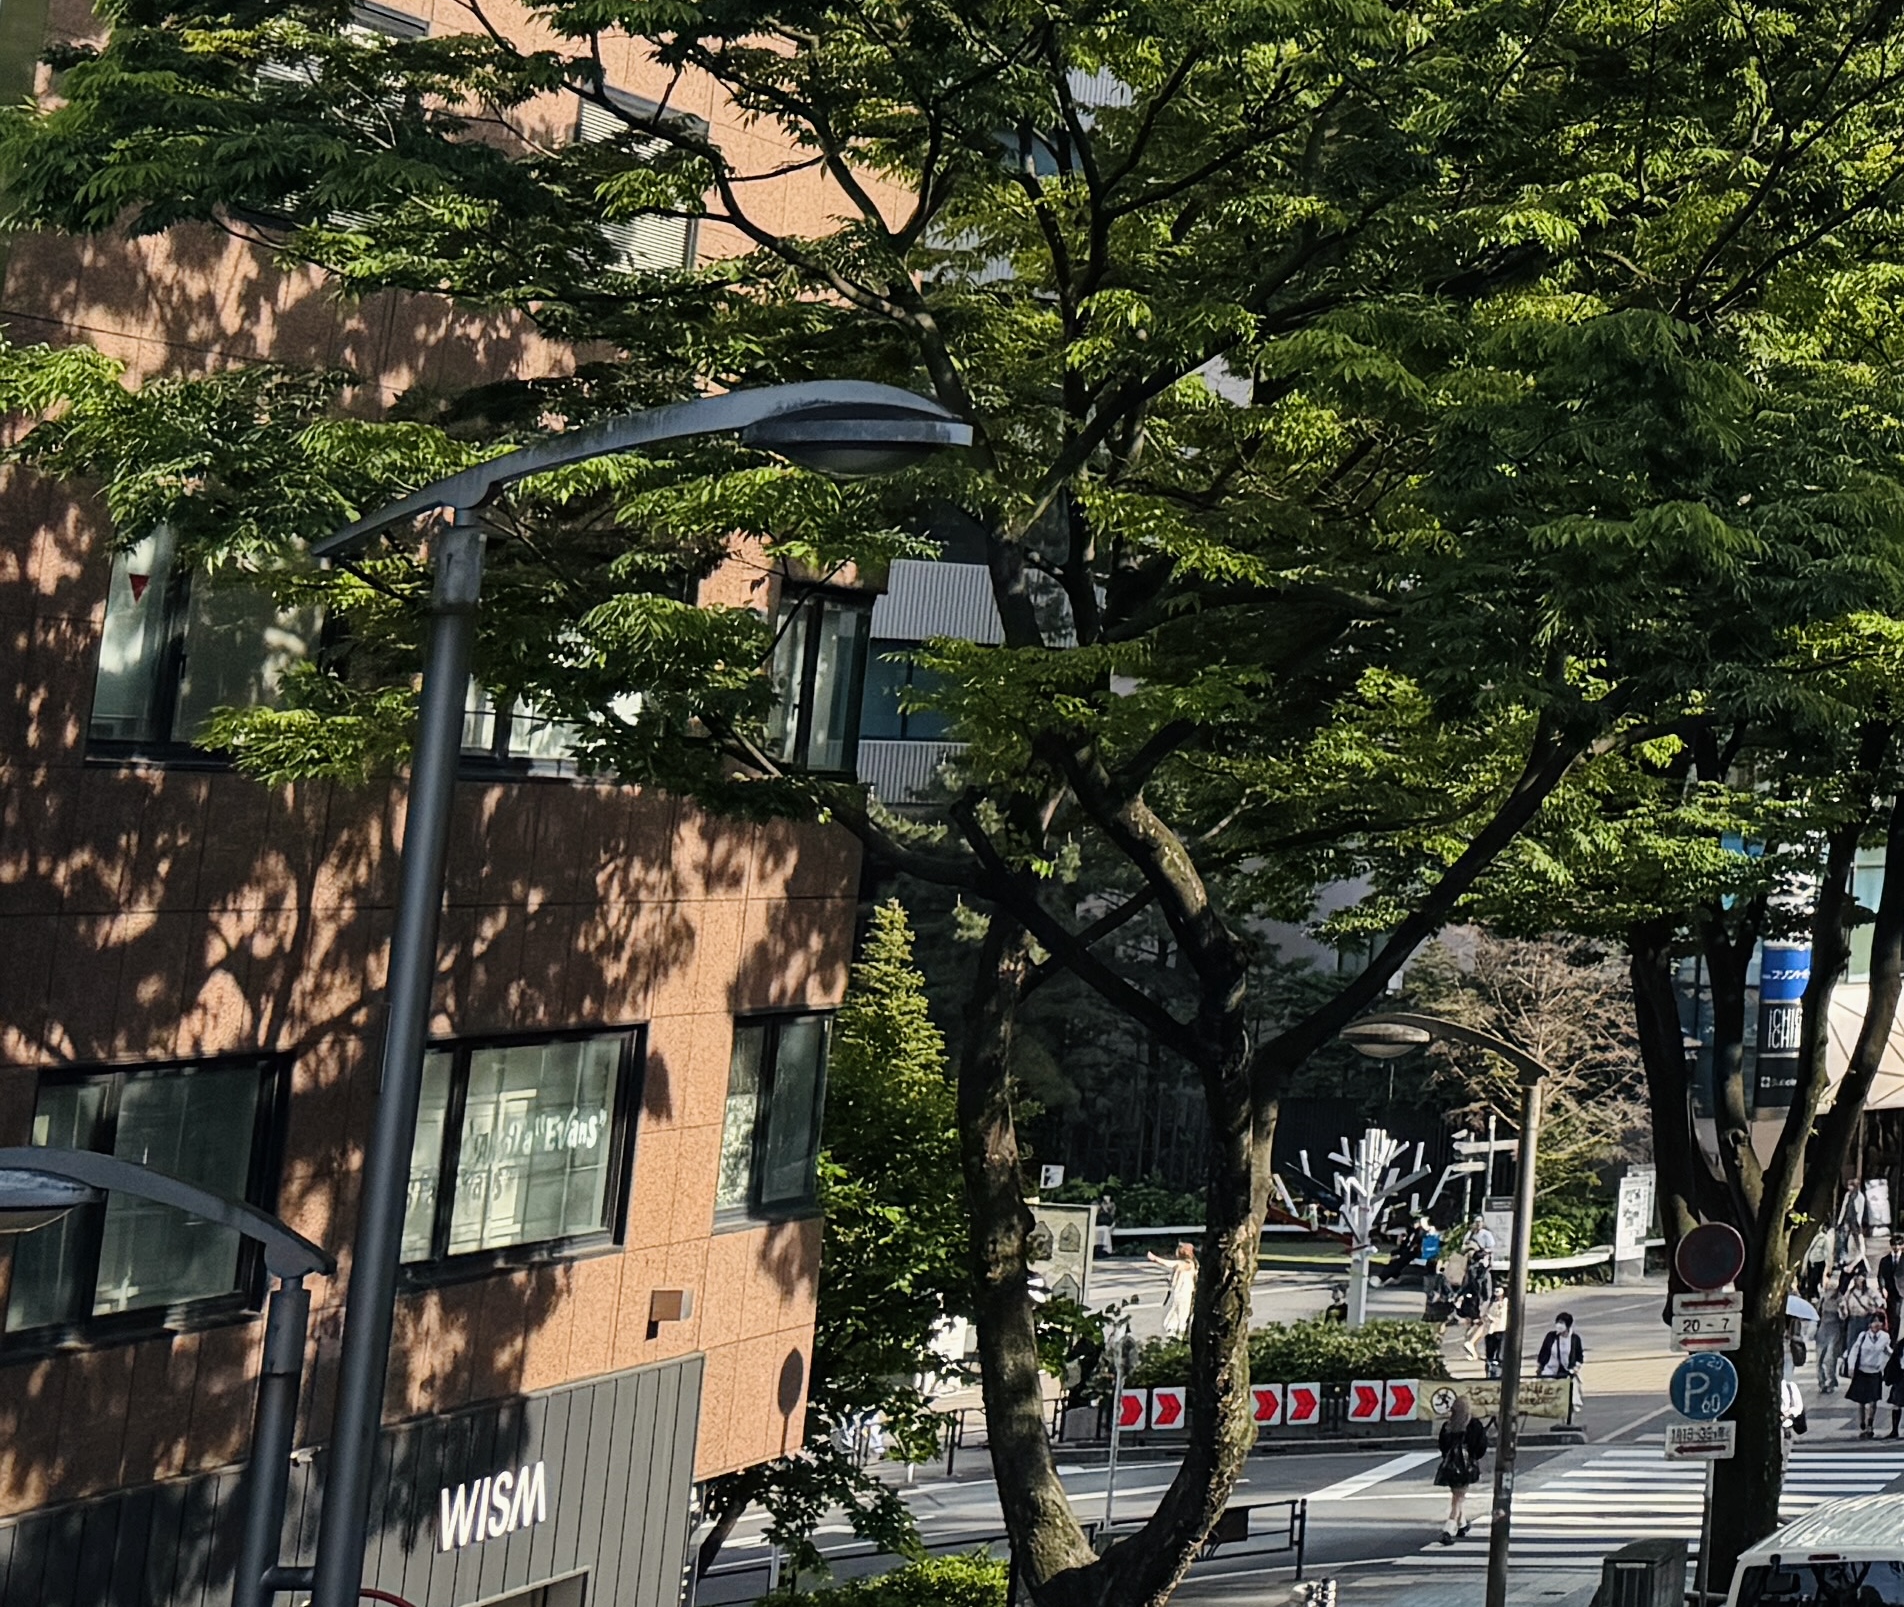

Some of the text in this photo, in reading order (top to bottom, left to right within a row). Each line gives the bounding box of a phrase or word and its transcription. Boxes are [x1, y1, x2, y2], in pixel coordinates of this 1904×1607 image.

[1684, 1372, 1710, 1413] P
[1701, 1394, 1720, 1413] 60
[437, 1461, 546, 1554] WISM
